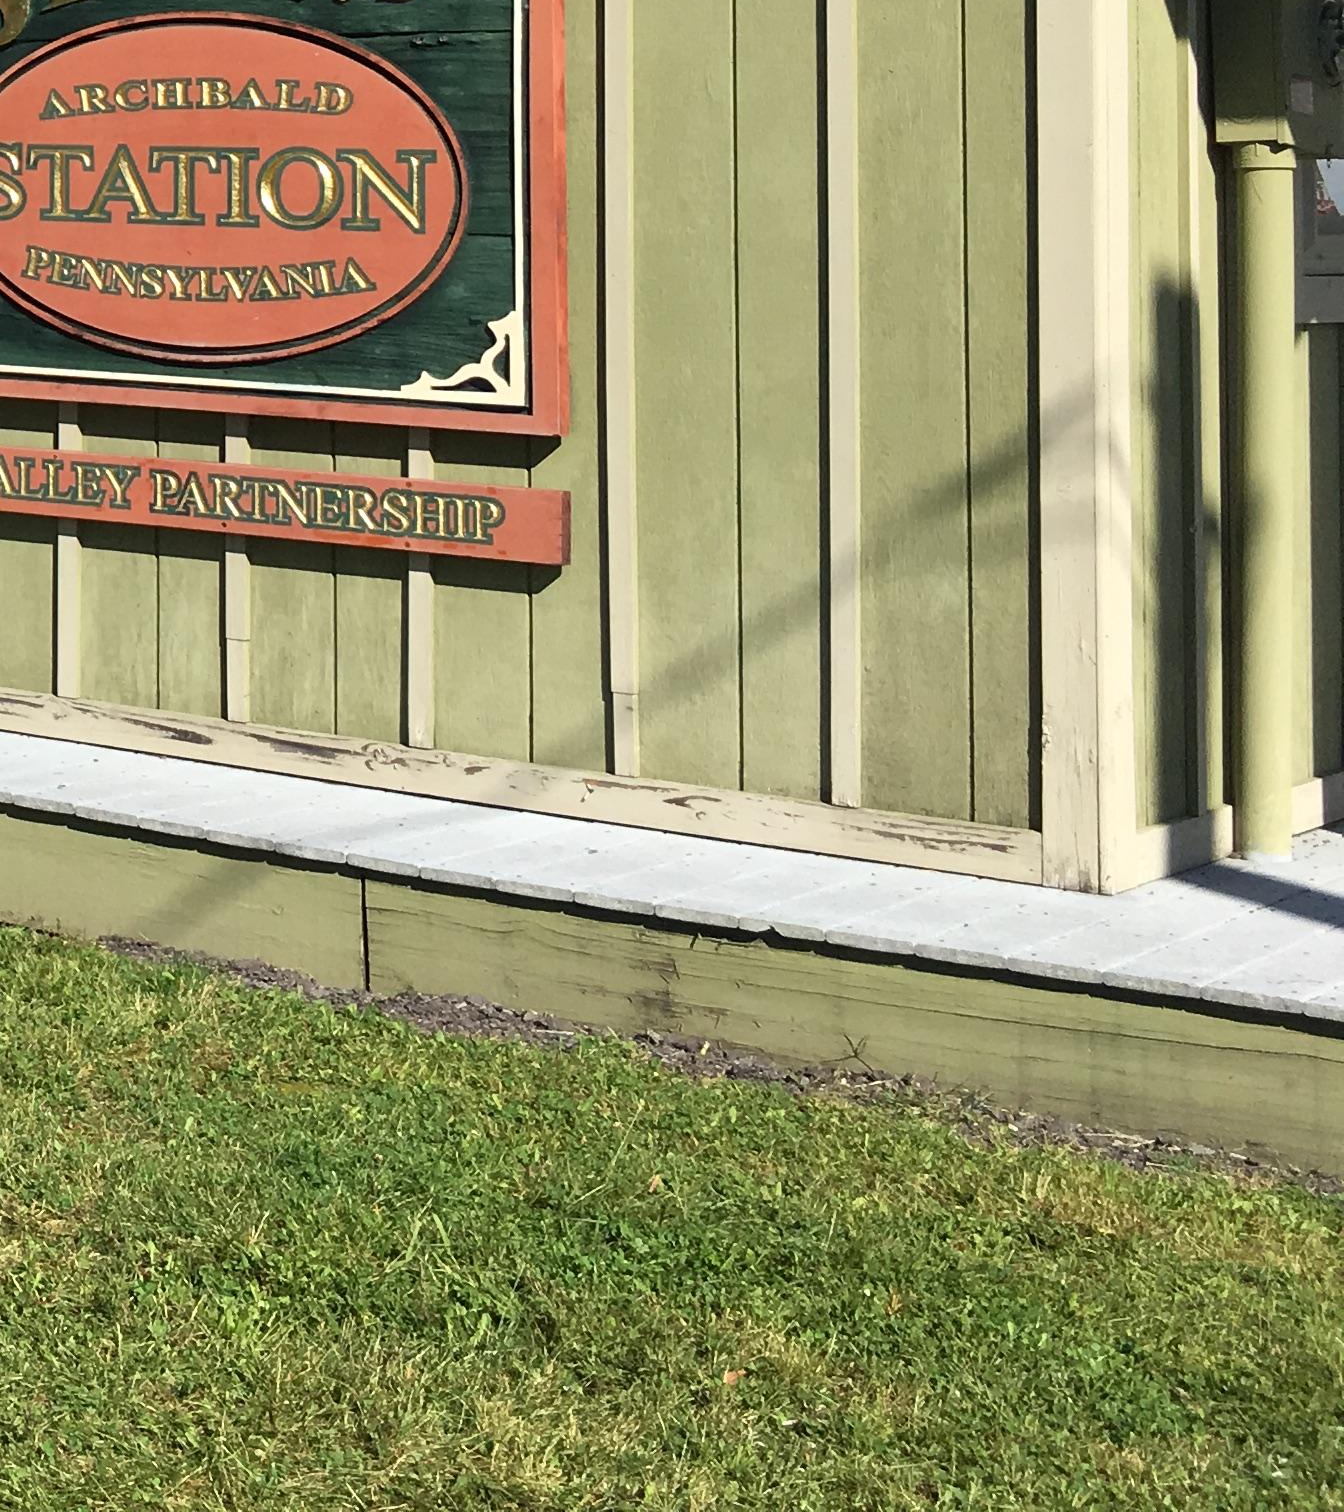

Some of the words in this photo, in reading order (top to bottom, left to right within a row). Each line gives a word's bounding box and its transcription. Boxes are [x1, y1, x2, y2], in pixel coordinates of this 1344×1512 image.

[39, 77, 354, 120] ARCHBALD
[20, 245, 377, 305] PENNSYLVANIA
[149, 468, 505, 546] PARTNERSHIP
